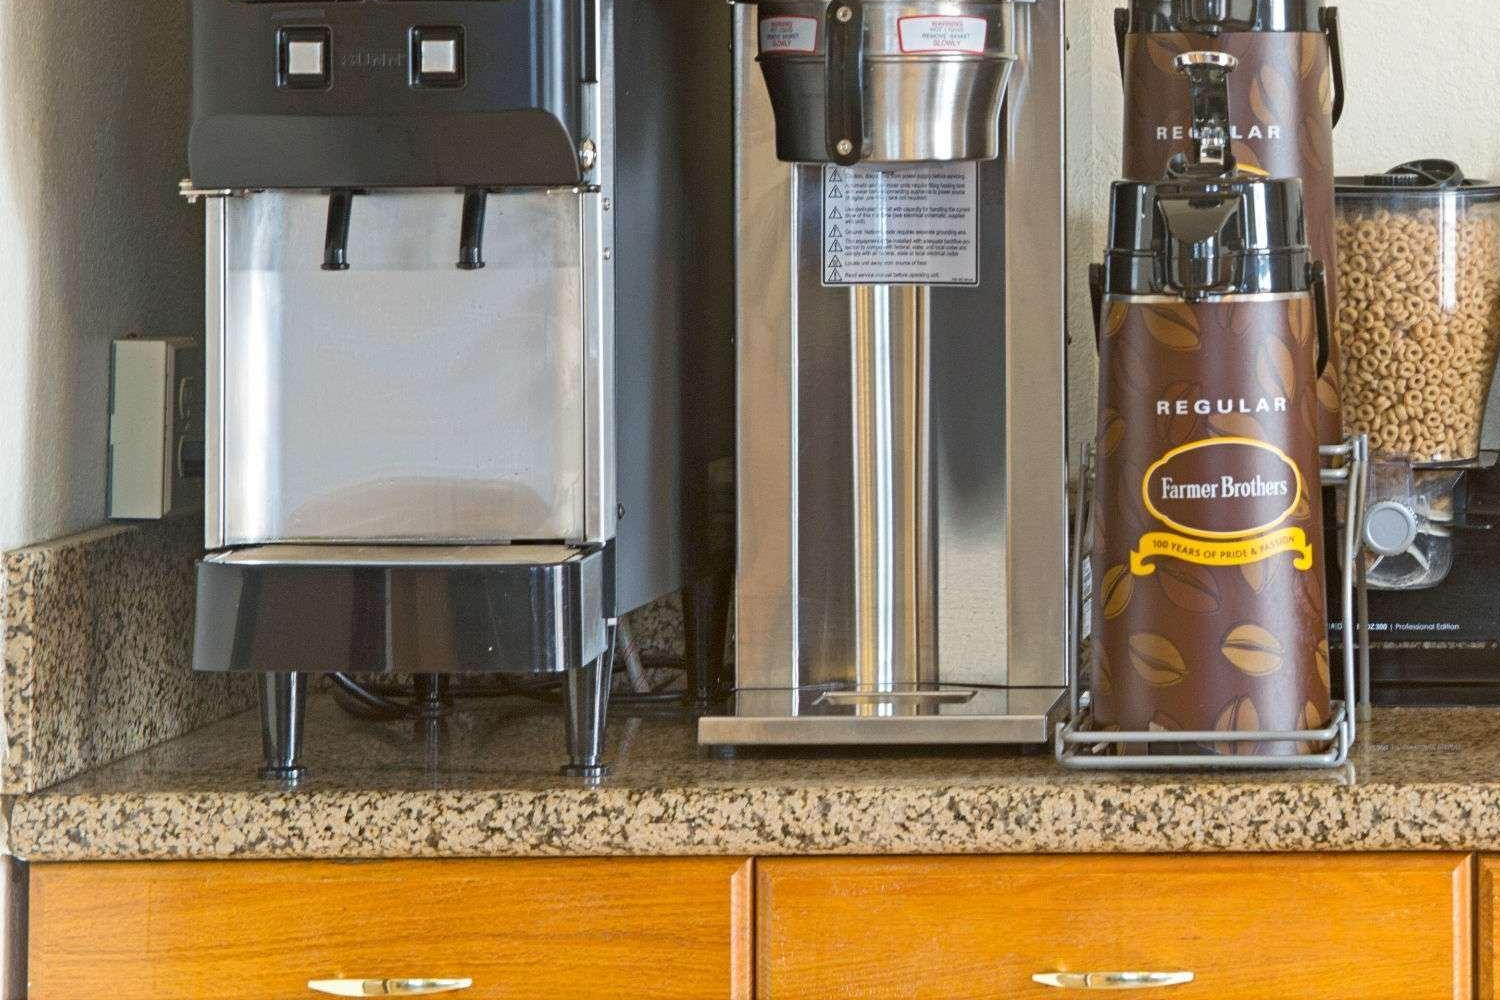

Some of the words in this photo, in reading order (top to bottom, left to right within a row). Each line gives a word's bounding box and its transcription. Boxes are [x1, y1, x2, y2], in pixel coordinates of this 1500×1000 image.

[1156, 124, 1281, 140] RELAR
[1156, 396, 1287, 416] REGULAR
[1161, 476, 1219, 500] Farmer
[1220, 475, 1288, 499] Brothers
[1153, 539, 1169, 549] 100
[1171, 543, 1201, 557] YEARS
[1203, 550, 1217, 559] OF
[1220, 550, 1248, 560] PRIDE
[1260, 535, 1296, 553] PASSION
[1395, 622, 1435, 631] Professional
[1436, 622, 1460, 631] Edition
